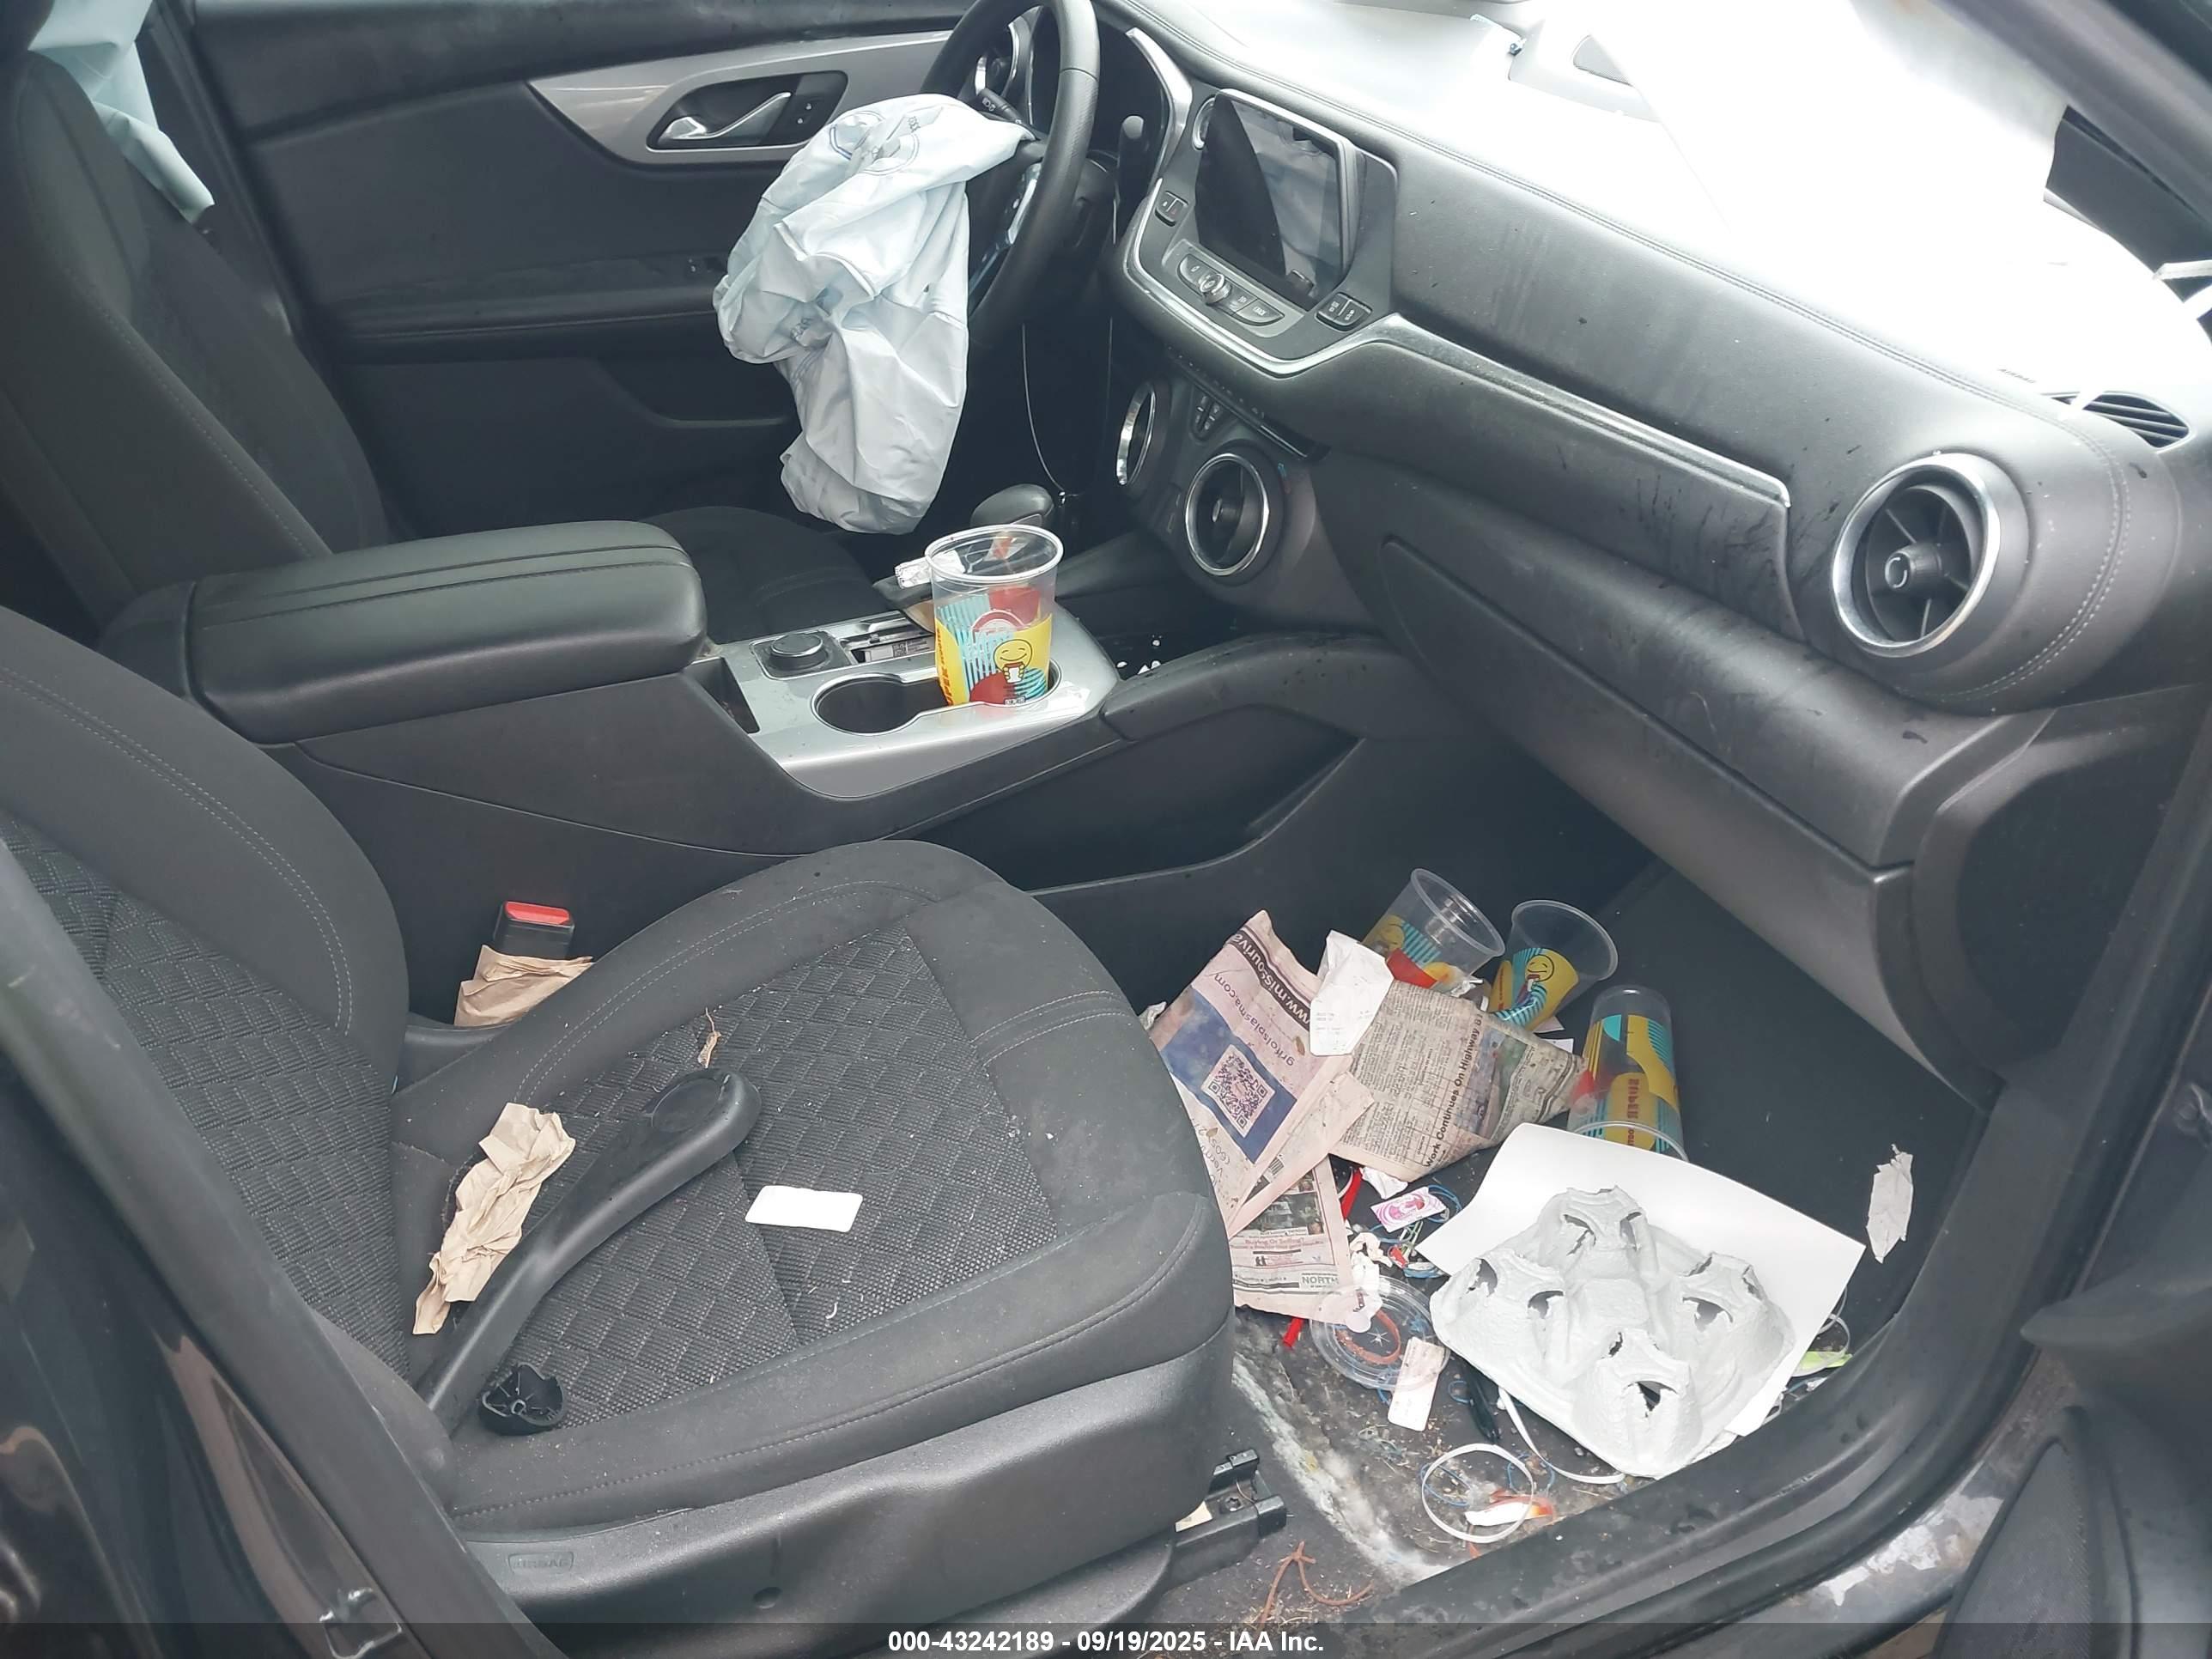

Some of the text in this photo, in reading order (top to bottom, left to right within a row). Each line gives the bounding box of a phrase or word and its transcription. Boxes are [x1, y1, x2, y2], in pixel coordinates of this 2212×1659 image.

[1233, 933, 1310, 1025] ww.missouriva
[1213, 972, 1296, 1066] grifolsplasma.com
[1458, 1028, 1480, 1071] Highway
[1455, 1073, 1465, 1087] On
[1436, 1090, 1460, 1140] Continues
[1424, 1143, 1442, 1167] Work
